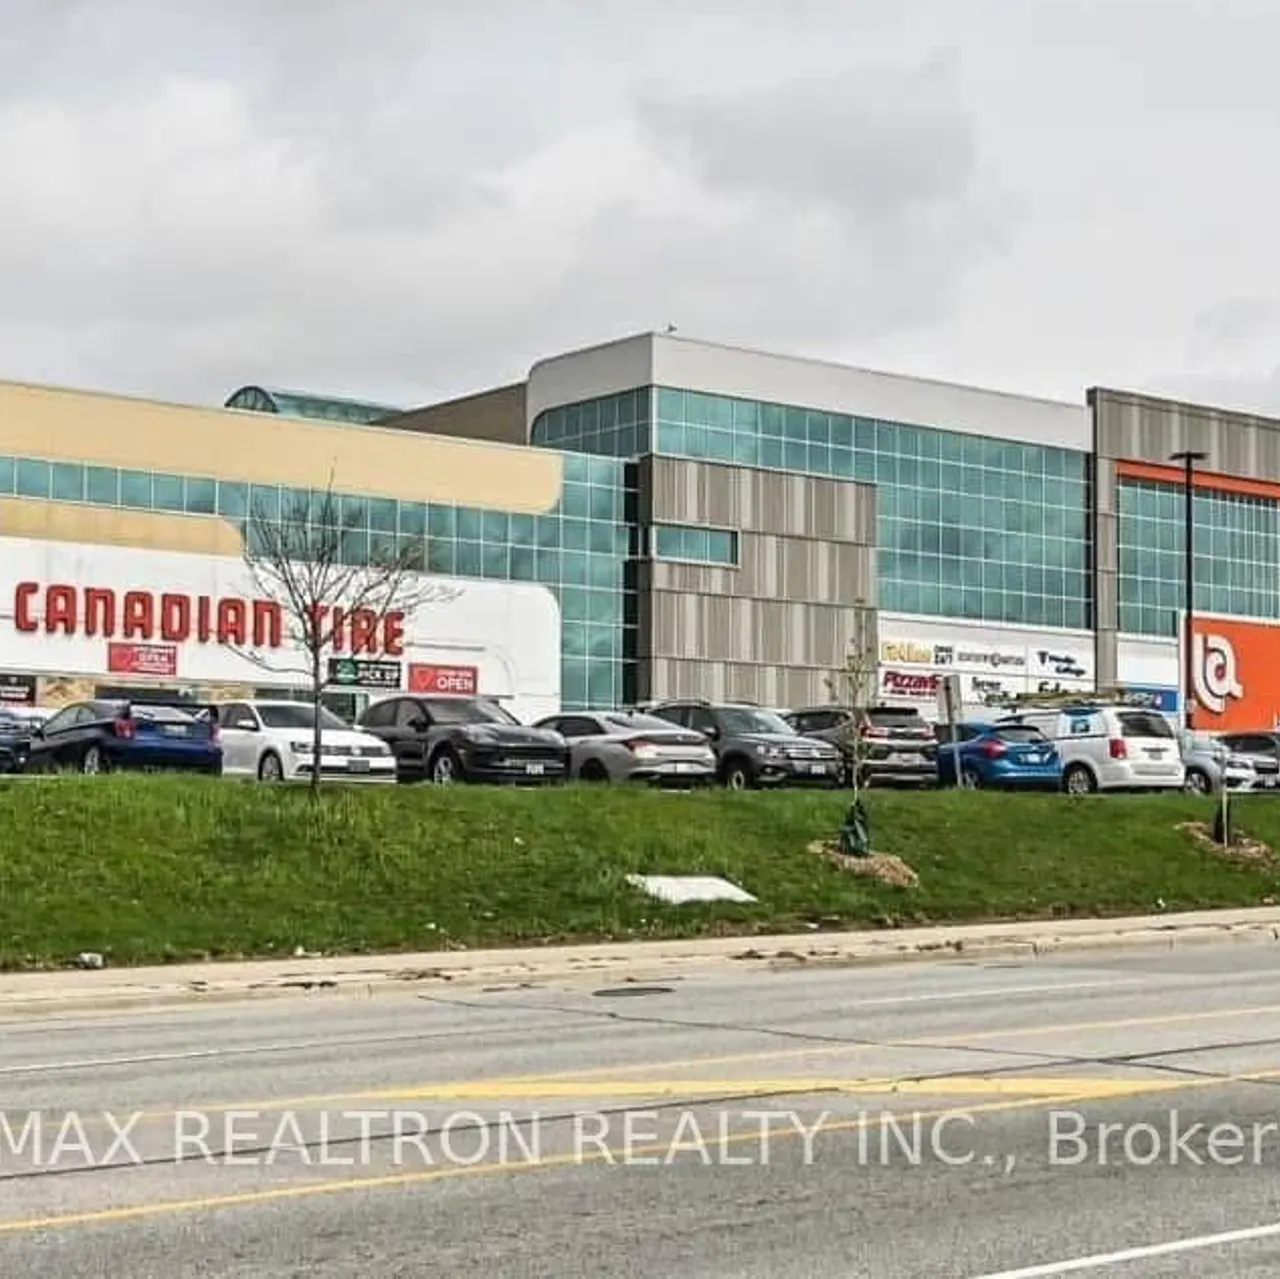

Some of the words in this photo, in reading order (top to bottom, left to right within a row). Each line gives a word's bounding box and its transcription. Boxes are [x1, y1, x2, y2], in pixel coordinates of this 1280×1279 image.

[14, 581, 283, 649] CANADIAN
[308, 601, 406, 656] TIRE
[436, 676, 473, 691] OPEN
